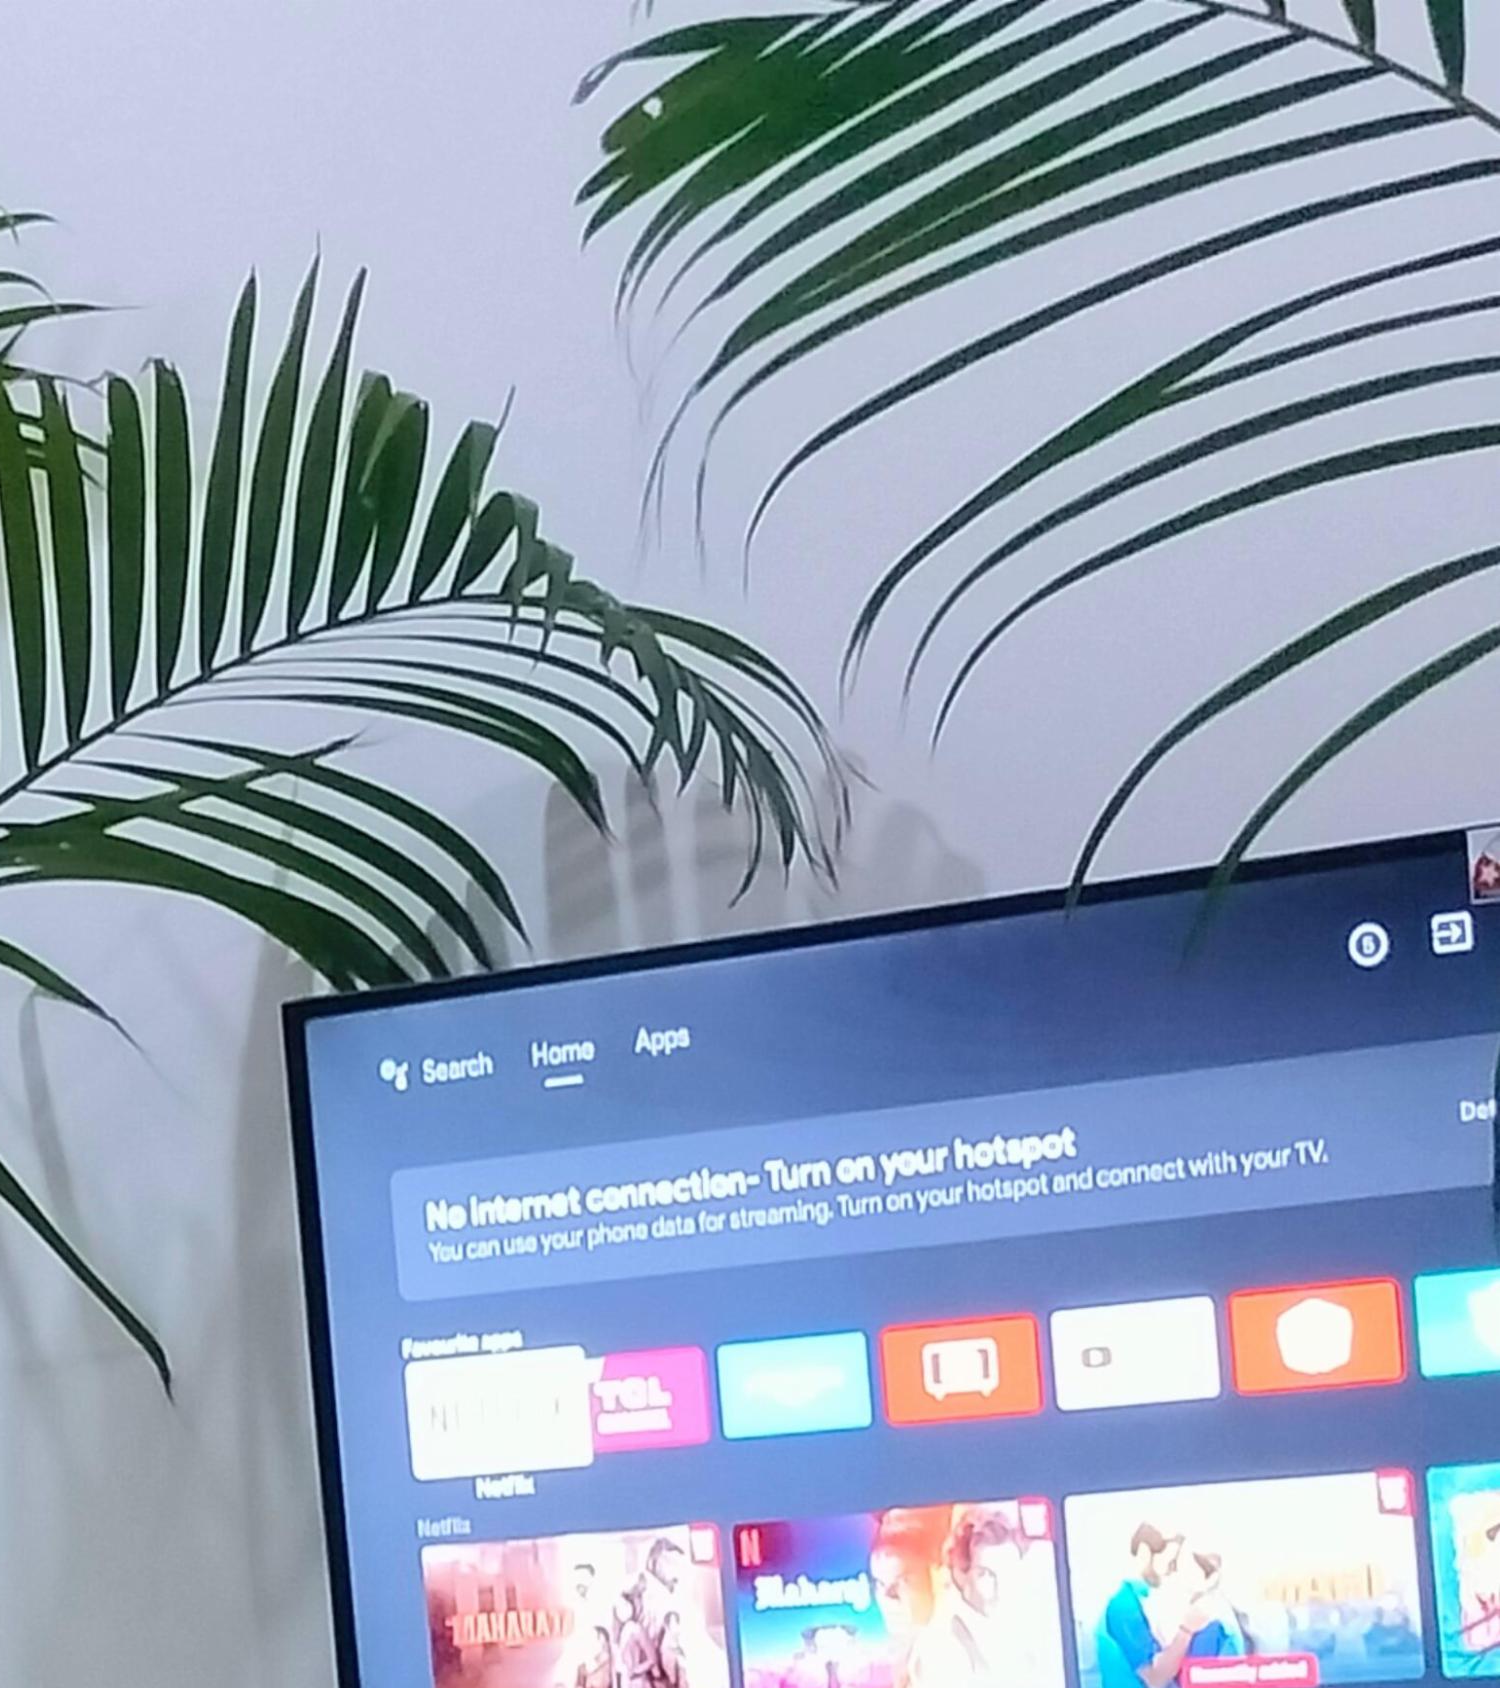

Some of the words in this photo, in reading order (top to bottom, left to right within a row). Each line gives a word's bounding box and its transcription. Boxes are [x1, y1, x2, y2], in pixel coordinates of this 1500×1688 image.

[530, 1040, 596, 1068] Home
[633, 1026, 691, 1056] Apps
[421, 1051, 494, 1084] Search
[424, 1198, 468, 1232] No
[763, 1158, 832, 1192] Turn
[835, 1154, 876, 1184] on
[879, 1145, 949, 1186] your
[952, 1126, 1077, 1170] hotspot
[428, 1241, 464, 1264] You
[465, 1238, 501, 1260] can
[503, 1235, 538, 1256] use
[539, 1229, 585, 1256] your
[587, 1221, 649, 1251] phone
[651, 1214, 696, 1239] data
[698, 1210, 725, 1233] for
[728, 1199, 835, 1226] streaming.
[836, 1194, 883, 1217] Turn
[885, 1191, 914, 1210] on
[915, 1186, 963, 1214] your
[966, 1172, 1050, 1203] hotspot
[1052, 1166, 1093, 1194] and
[1095, 1156, 1186, 1189] connect
[1187, 1151, 1237, 1178] with
[1238, 1147, 1292, 1177] your
[1293, 1137, 1329, 1165] TV.
[416, 1516, 472, 1538] Netflix
